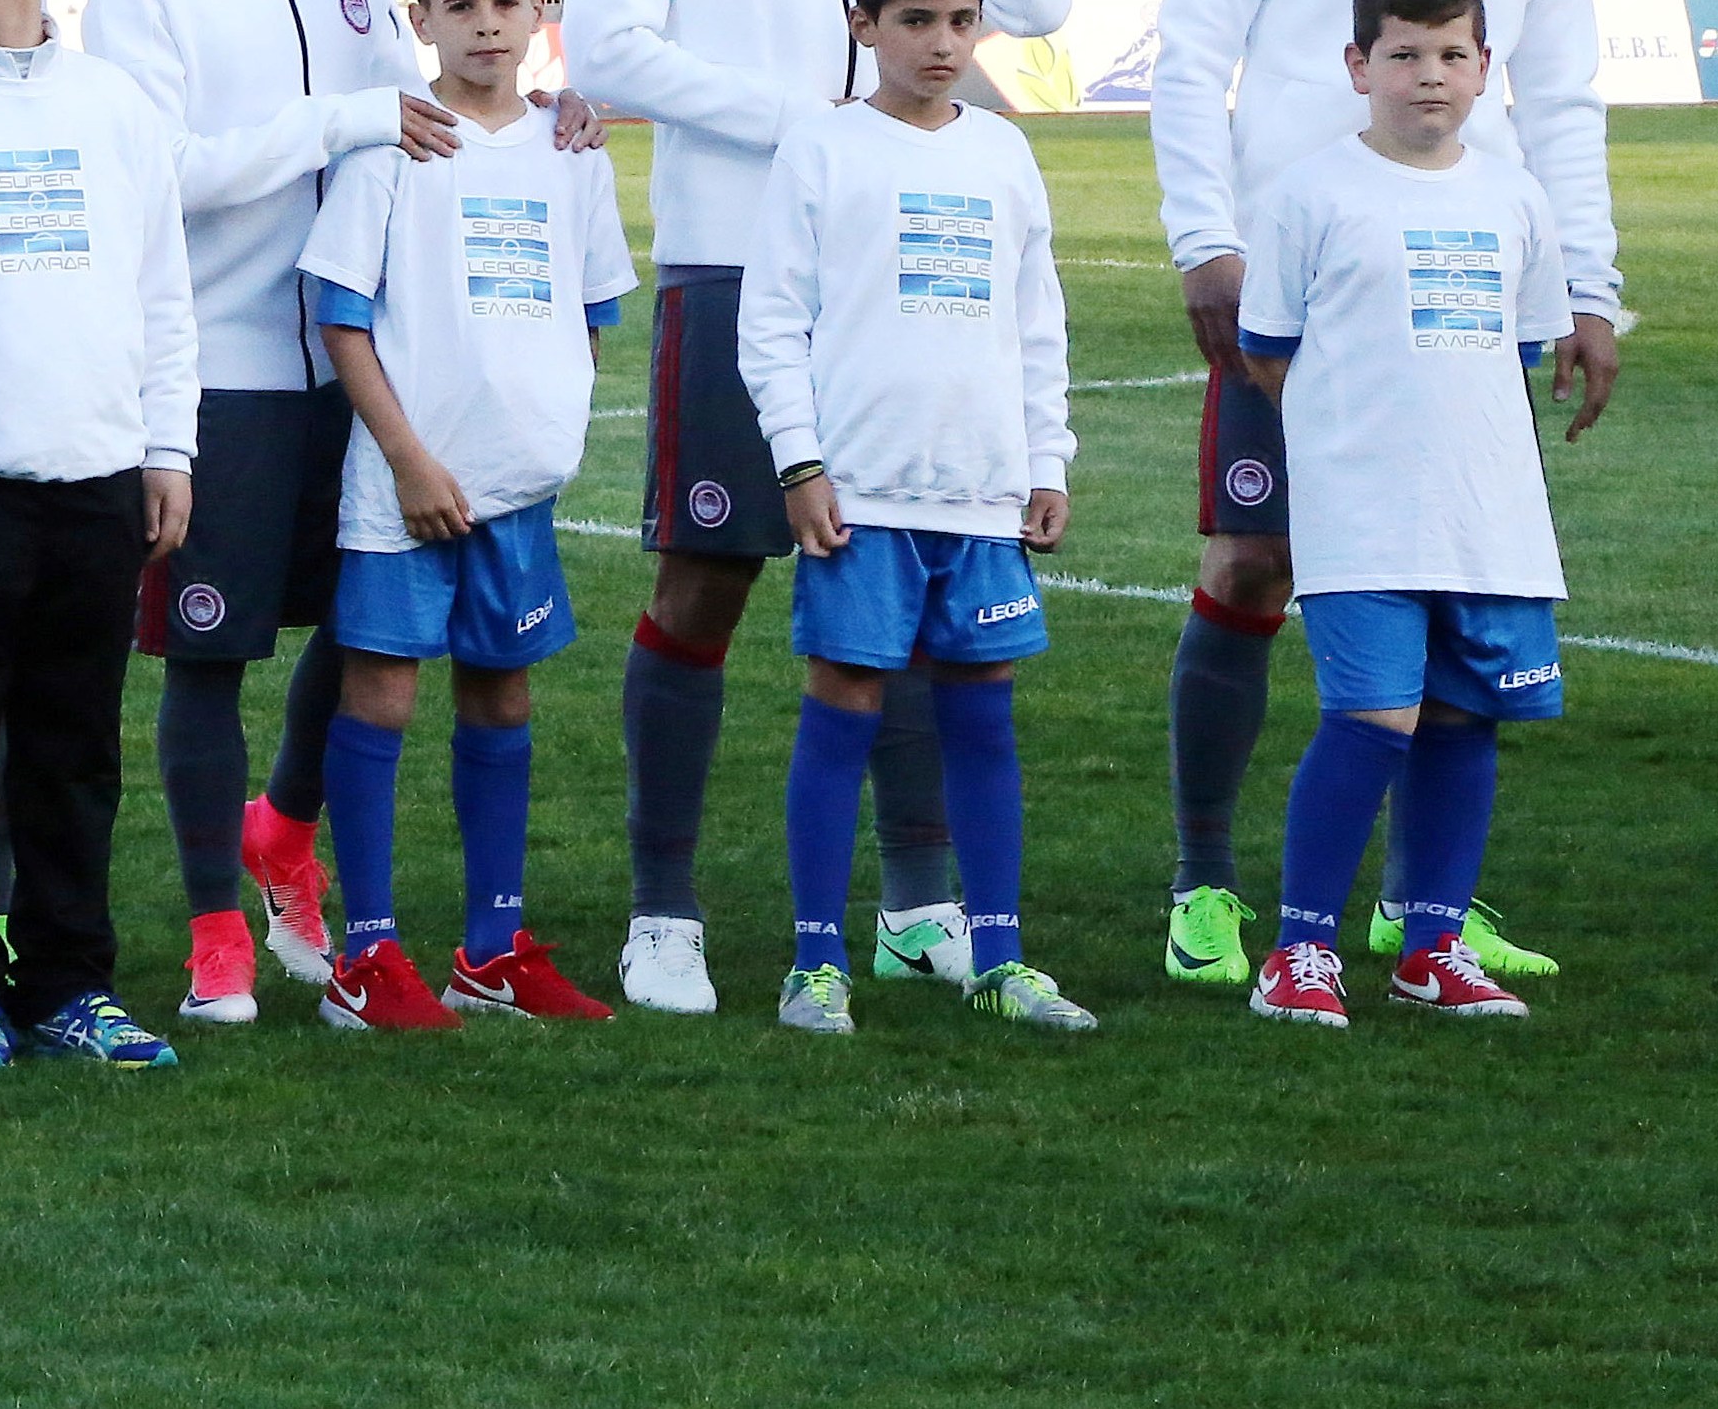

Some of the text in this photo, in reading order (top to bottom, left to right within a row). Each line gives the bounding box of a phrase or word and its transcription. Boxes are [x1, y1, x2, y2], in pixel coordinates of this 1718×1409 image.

[471, 220, 543, 238] SUPER
[908, 216, 986, 235] SUPER
[0, 256, 92, 274] ΕΛΛΑΔΑ
[467, 260, 550, 279] LEAGUE
[899, 256, 991, 278] LEAGUE
[1416, 252, 1494, 268] SUPER
[900, 299, 991, 319] ΕΛΛΑΔΑ
[1411, 292, 1501, 309] LEAGUE
[977, 594, 1039, 625] LEGEA
[1498, 662, 1562, 690] LEGEA
